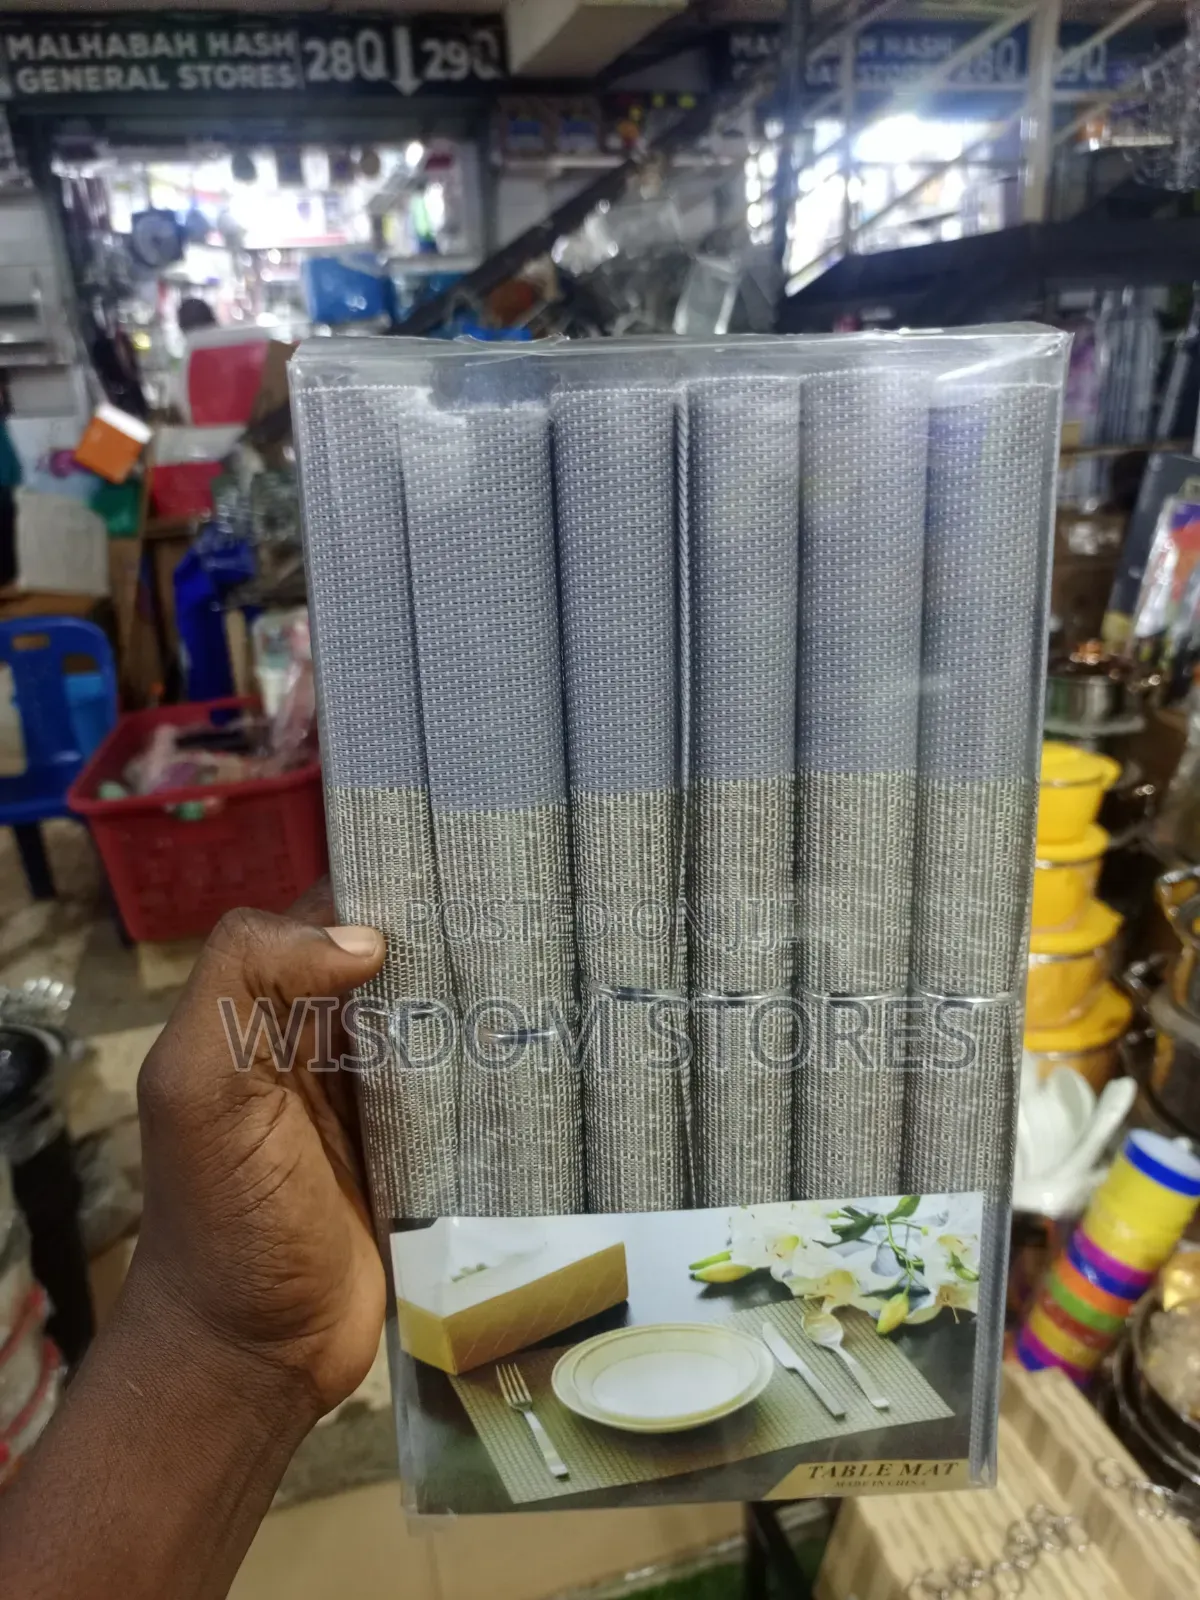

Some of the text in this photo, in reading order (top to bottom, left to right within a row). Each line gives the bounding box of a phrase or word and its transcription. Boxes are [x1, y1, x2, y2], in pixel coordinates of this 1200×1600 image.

[7, 32, 296, 60] MALHABAH HASH
[16, 63, 298, 93] GENERAL STORES
[808, 1462, 959, 1479] TABLE MAT
